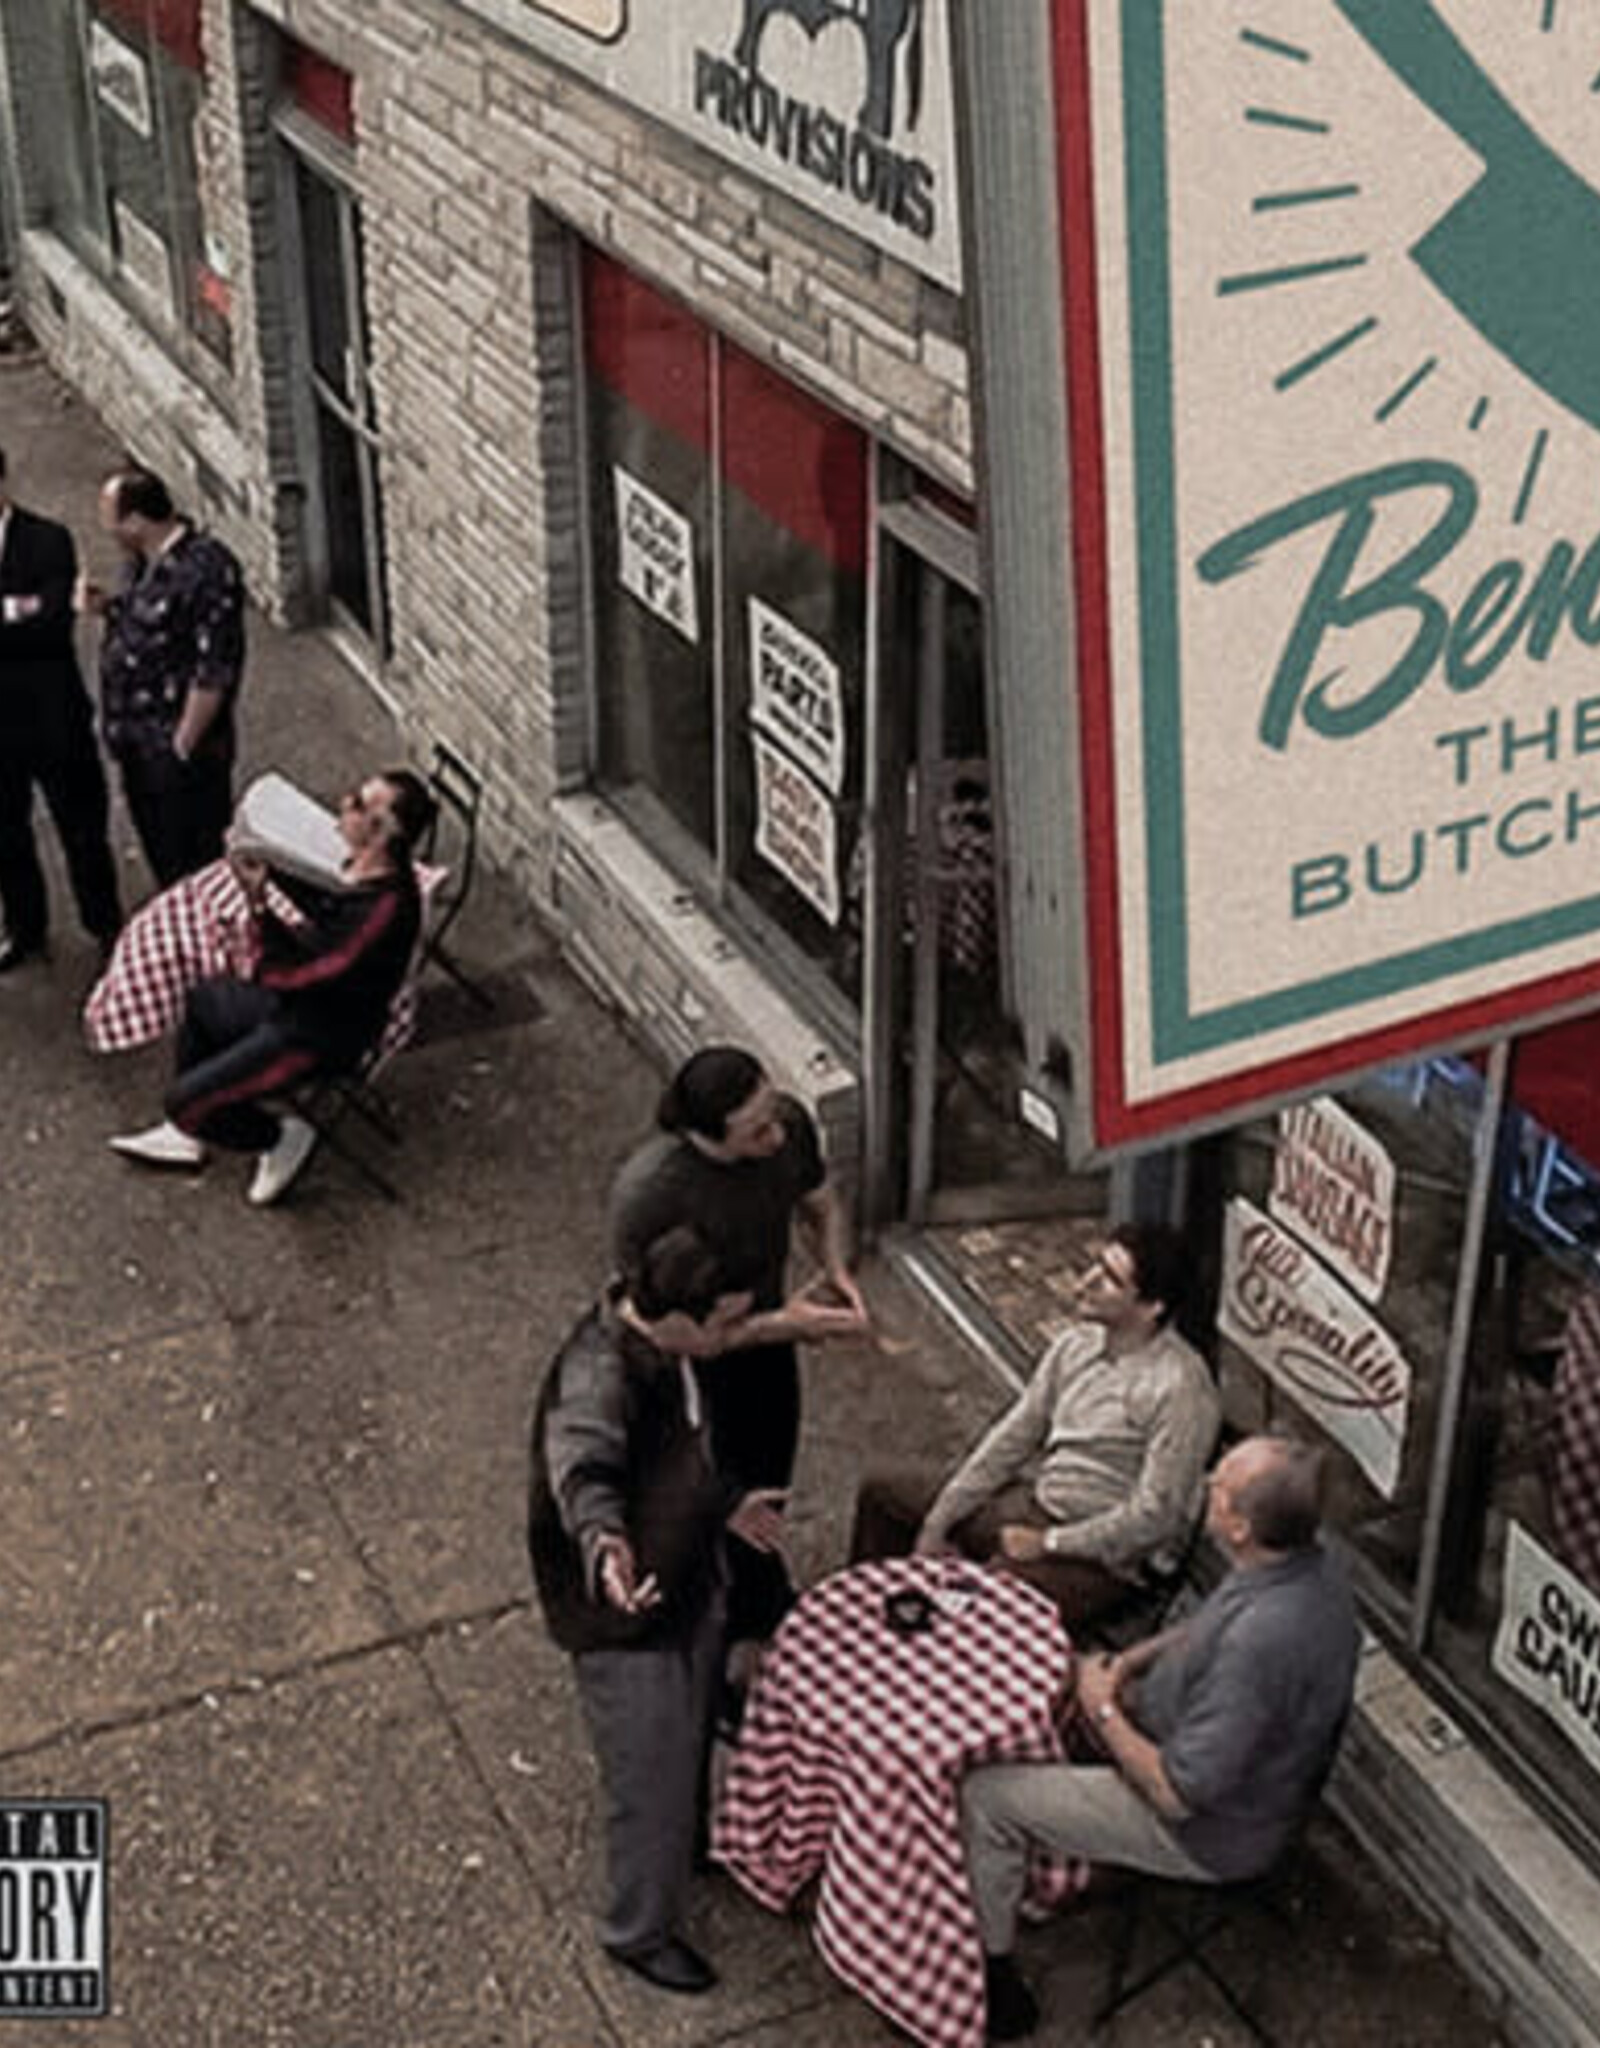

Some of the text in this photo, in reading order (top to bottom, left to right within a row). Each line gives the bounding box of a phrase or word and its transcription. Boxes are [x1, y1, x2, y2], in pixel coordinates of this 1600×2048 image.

[694, 48, 934, 241] PROVISIONS
[1436, 697, 1600, 786] THE
[1292, 791, 1600, 919] BUTCH
